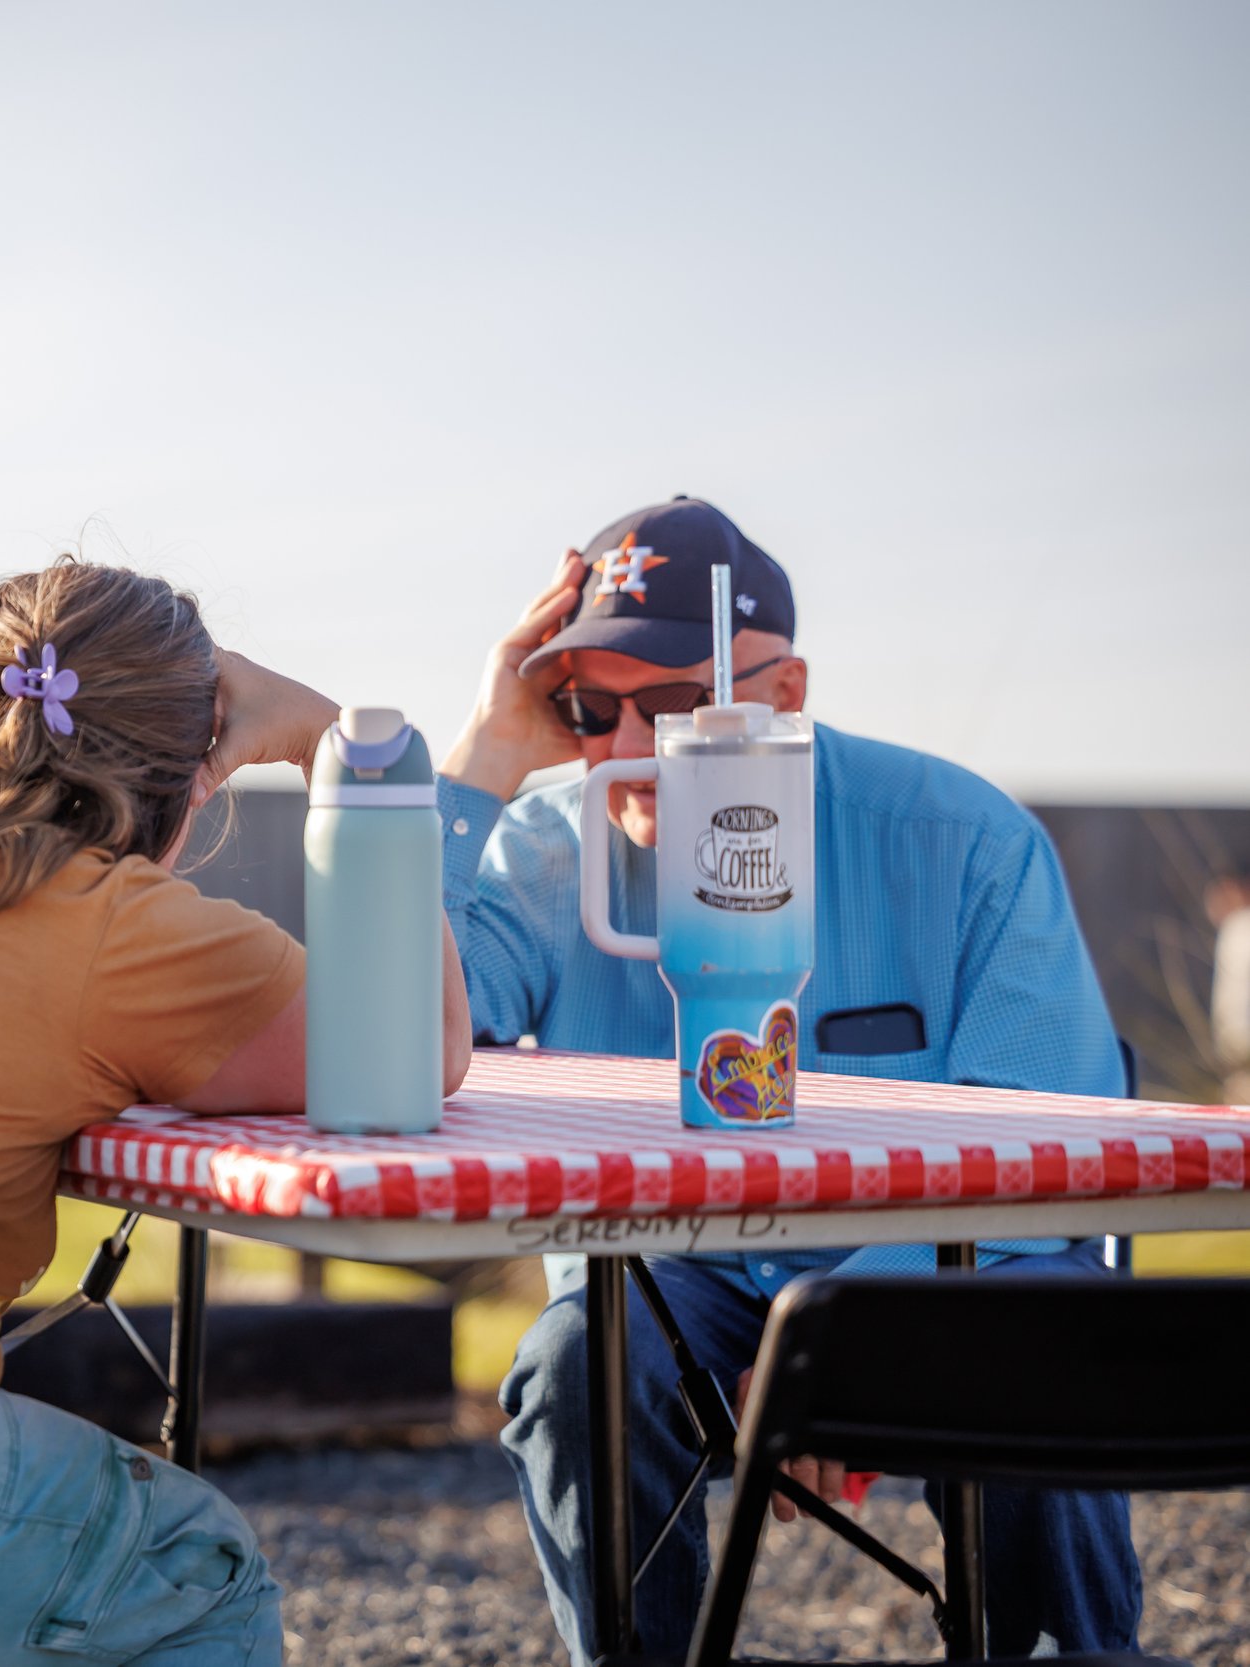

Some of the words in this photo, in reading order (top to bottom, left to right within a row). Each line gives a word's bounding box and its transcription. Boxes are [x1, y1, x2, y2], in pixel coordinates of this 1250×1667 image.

[597, 546, 652, 594] H
[715, 807, 775, 831] MORNINGS
[720, 847, 771, 889] COFFEE
[776, 862, 788, 886] &
[708, 1032, 790, 1086] Embrace
